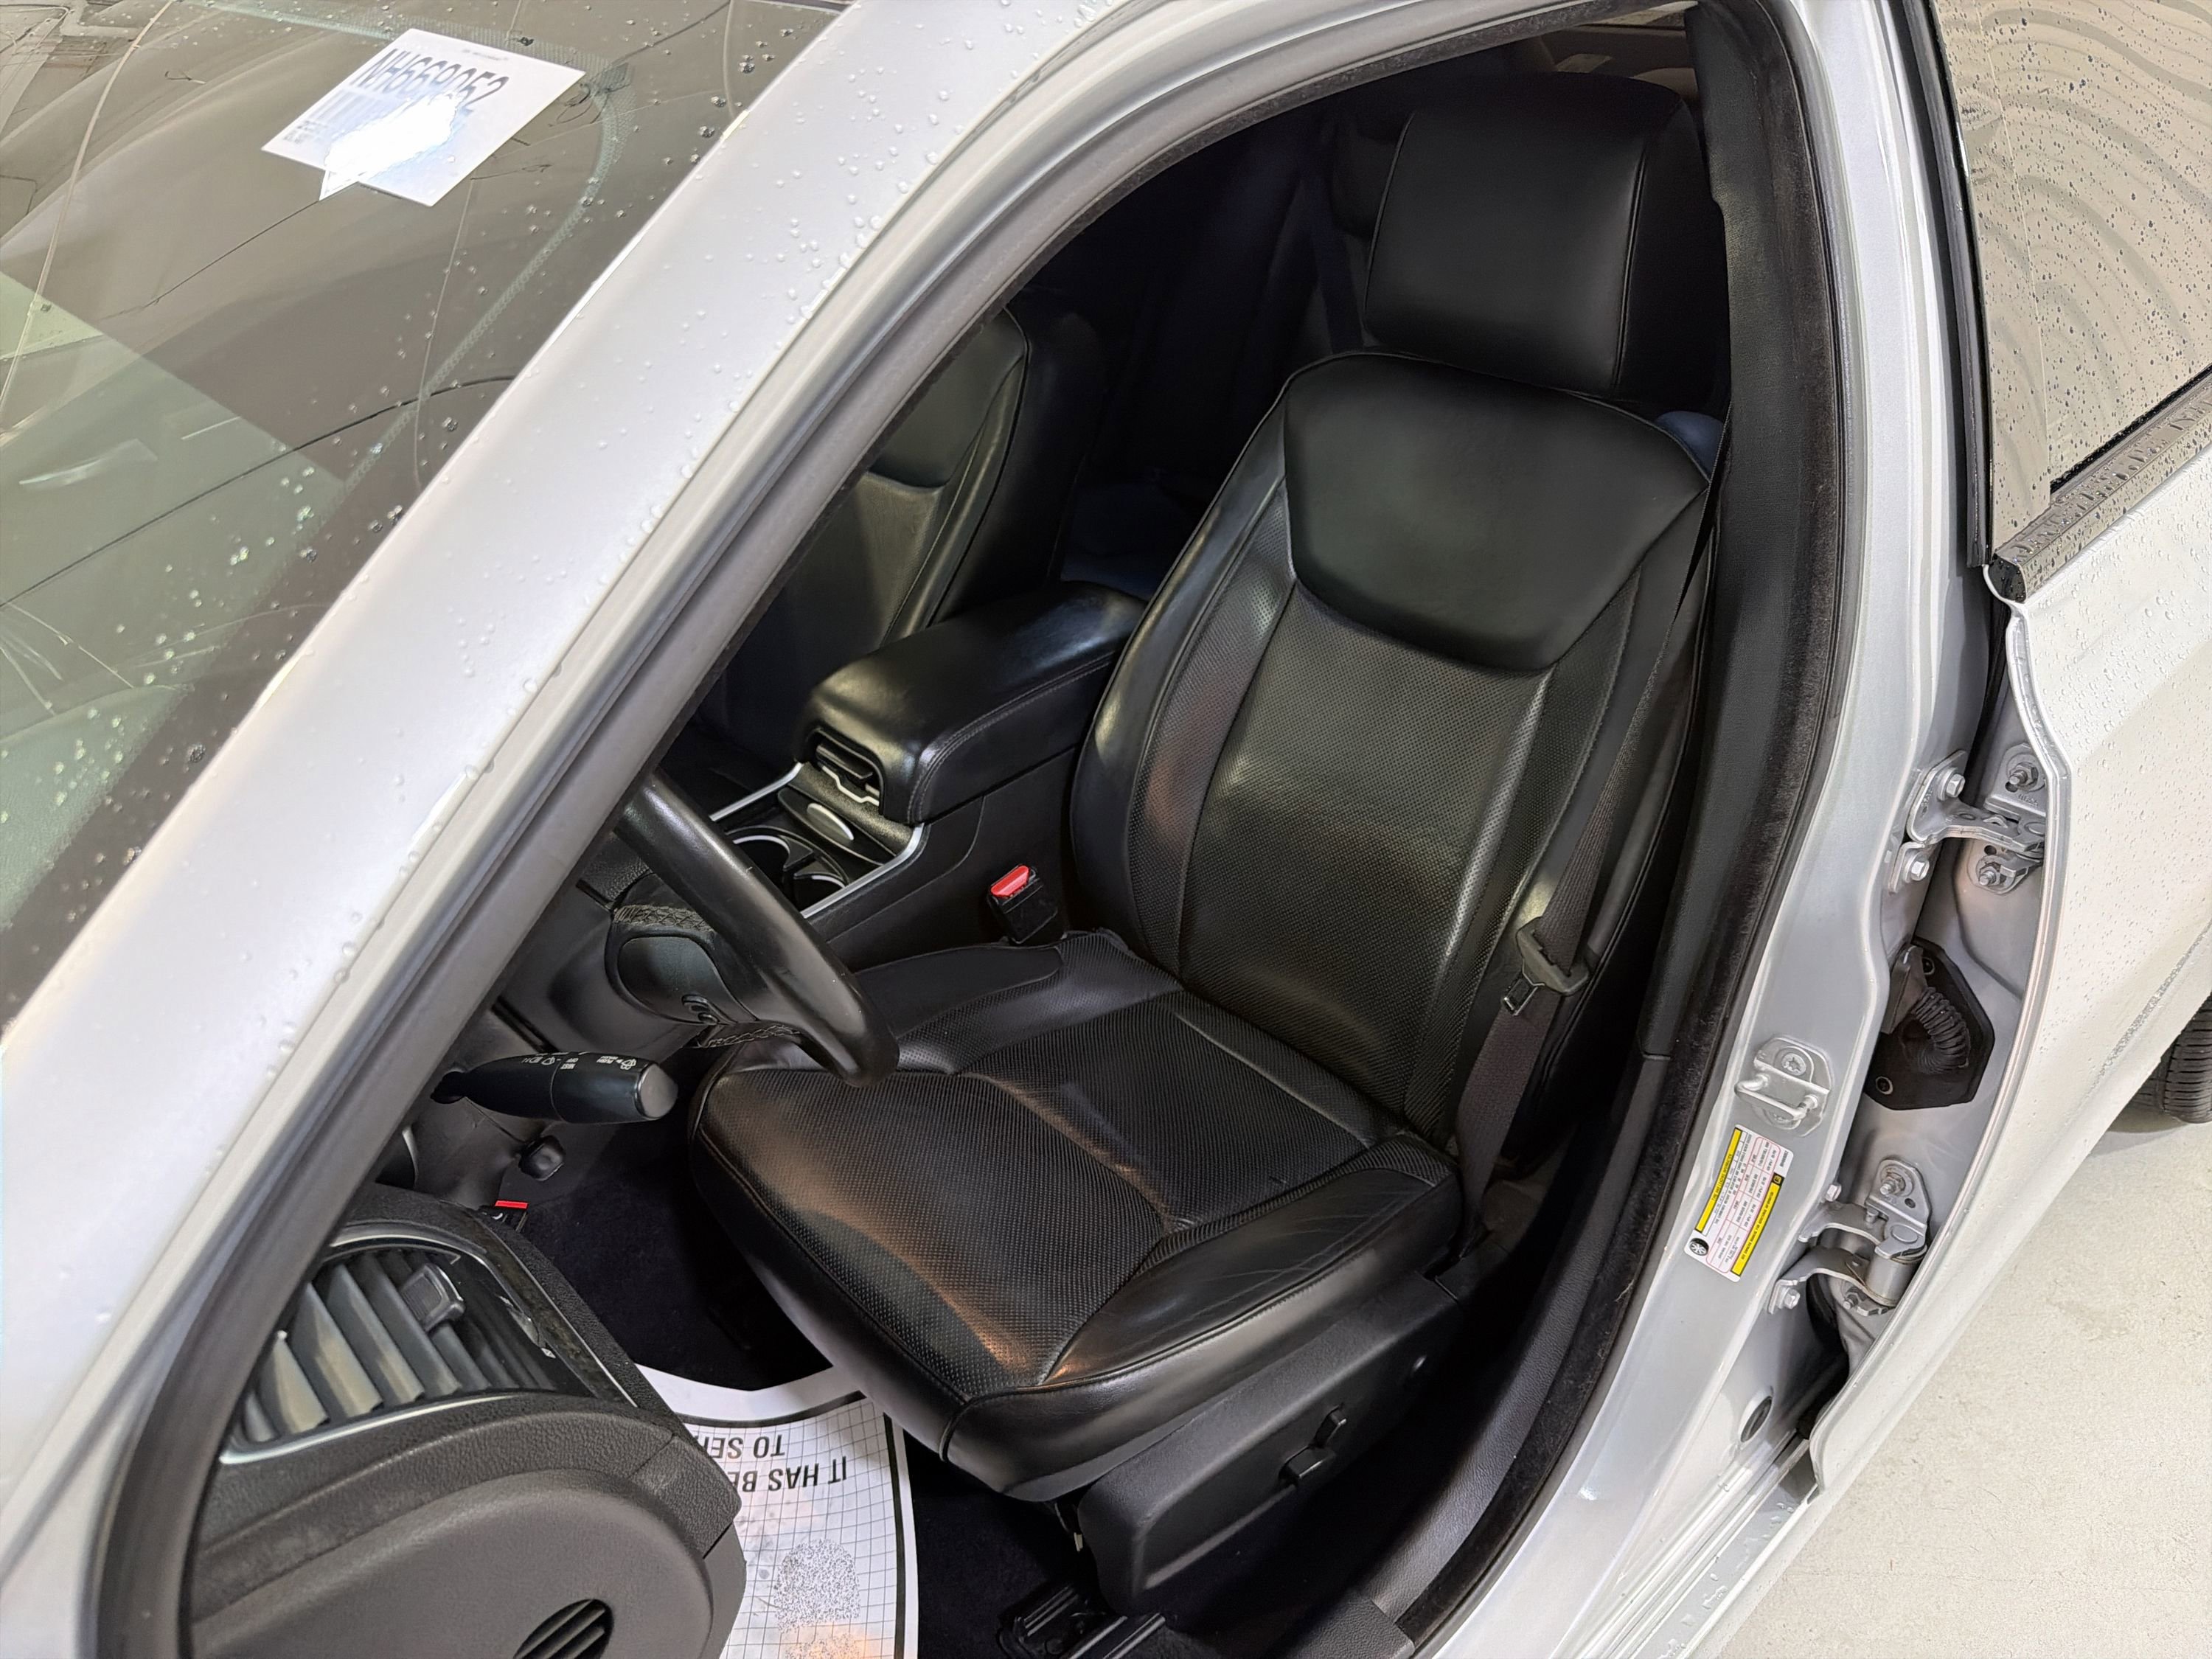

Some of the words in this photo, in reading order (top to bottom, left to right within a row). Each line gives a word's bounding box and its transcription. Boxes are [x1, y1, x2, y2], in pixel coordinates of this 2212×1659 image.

[753, 1434, 785, 1459] TO
[768, 1462, 820, 1492] HAS
[827, 1455, 847, 1484] IT
